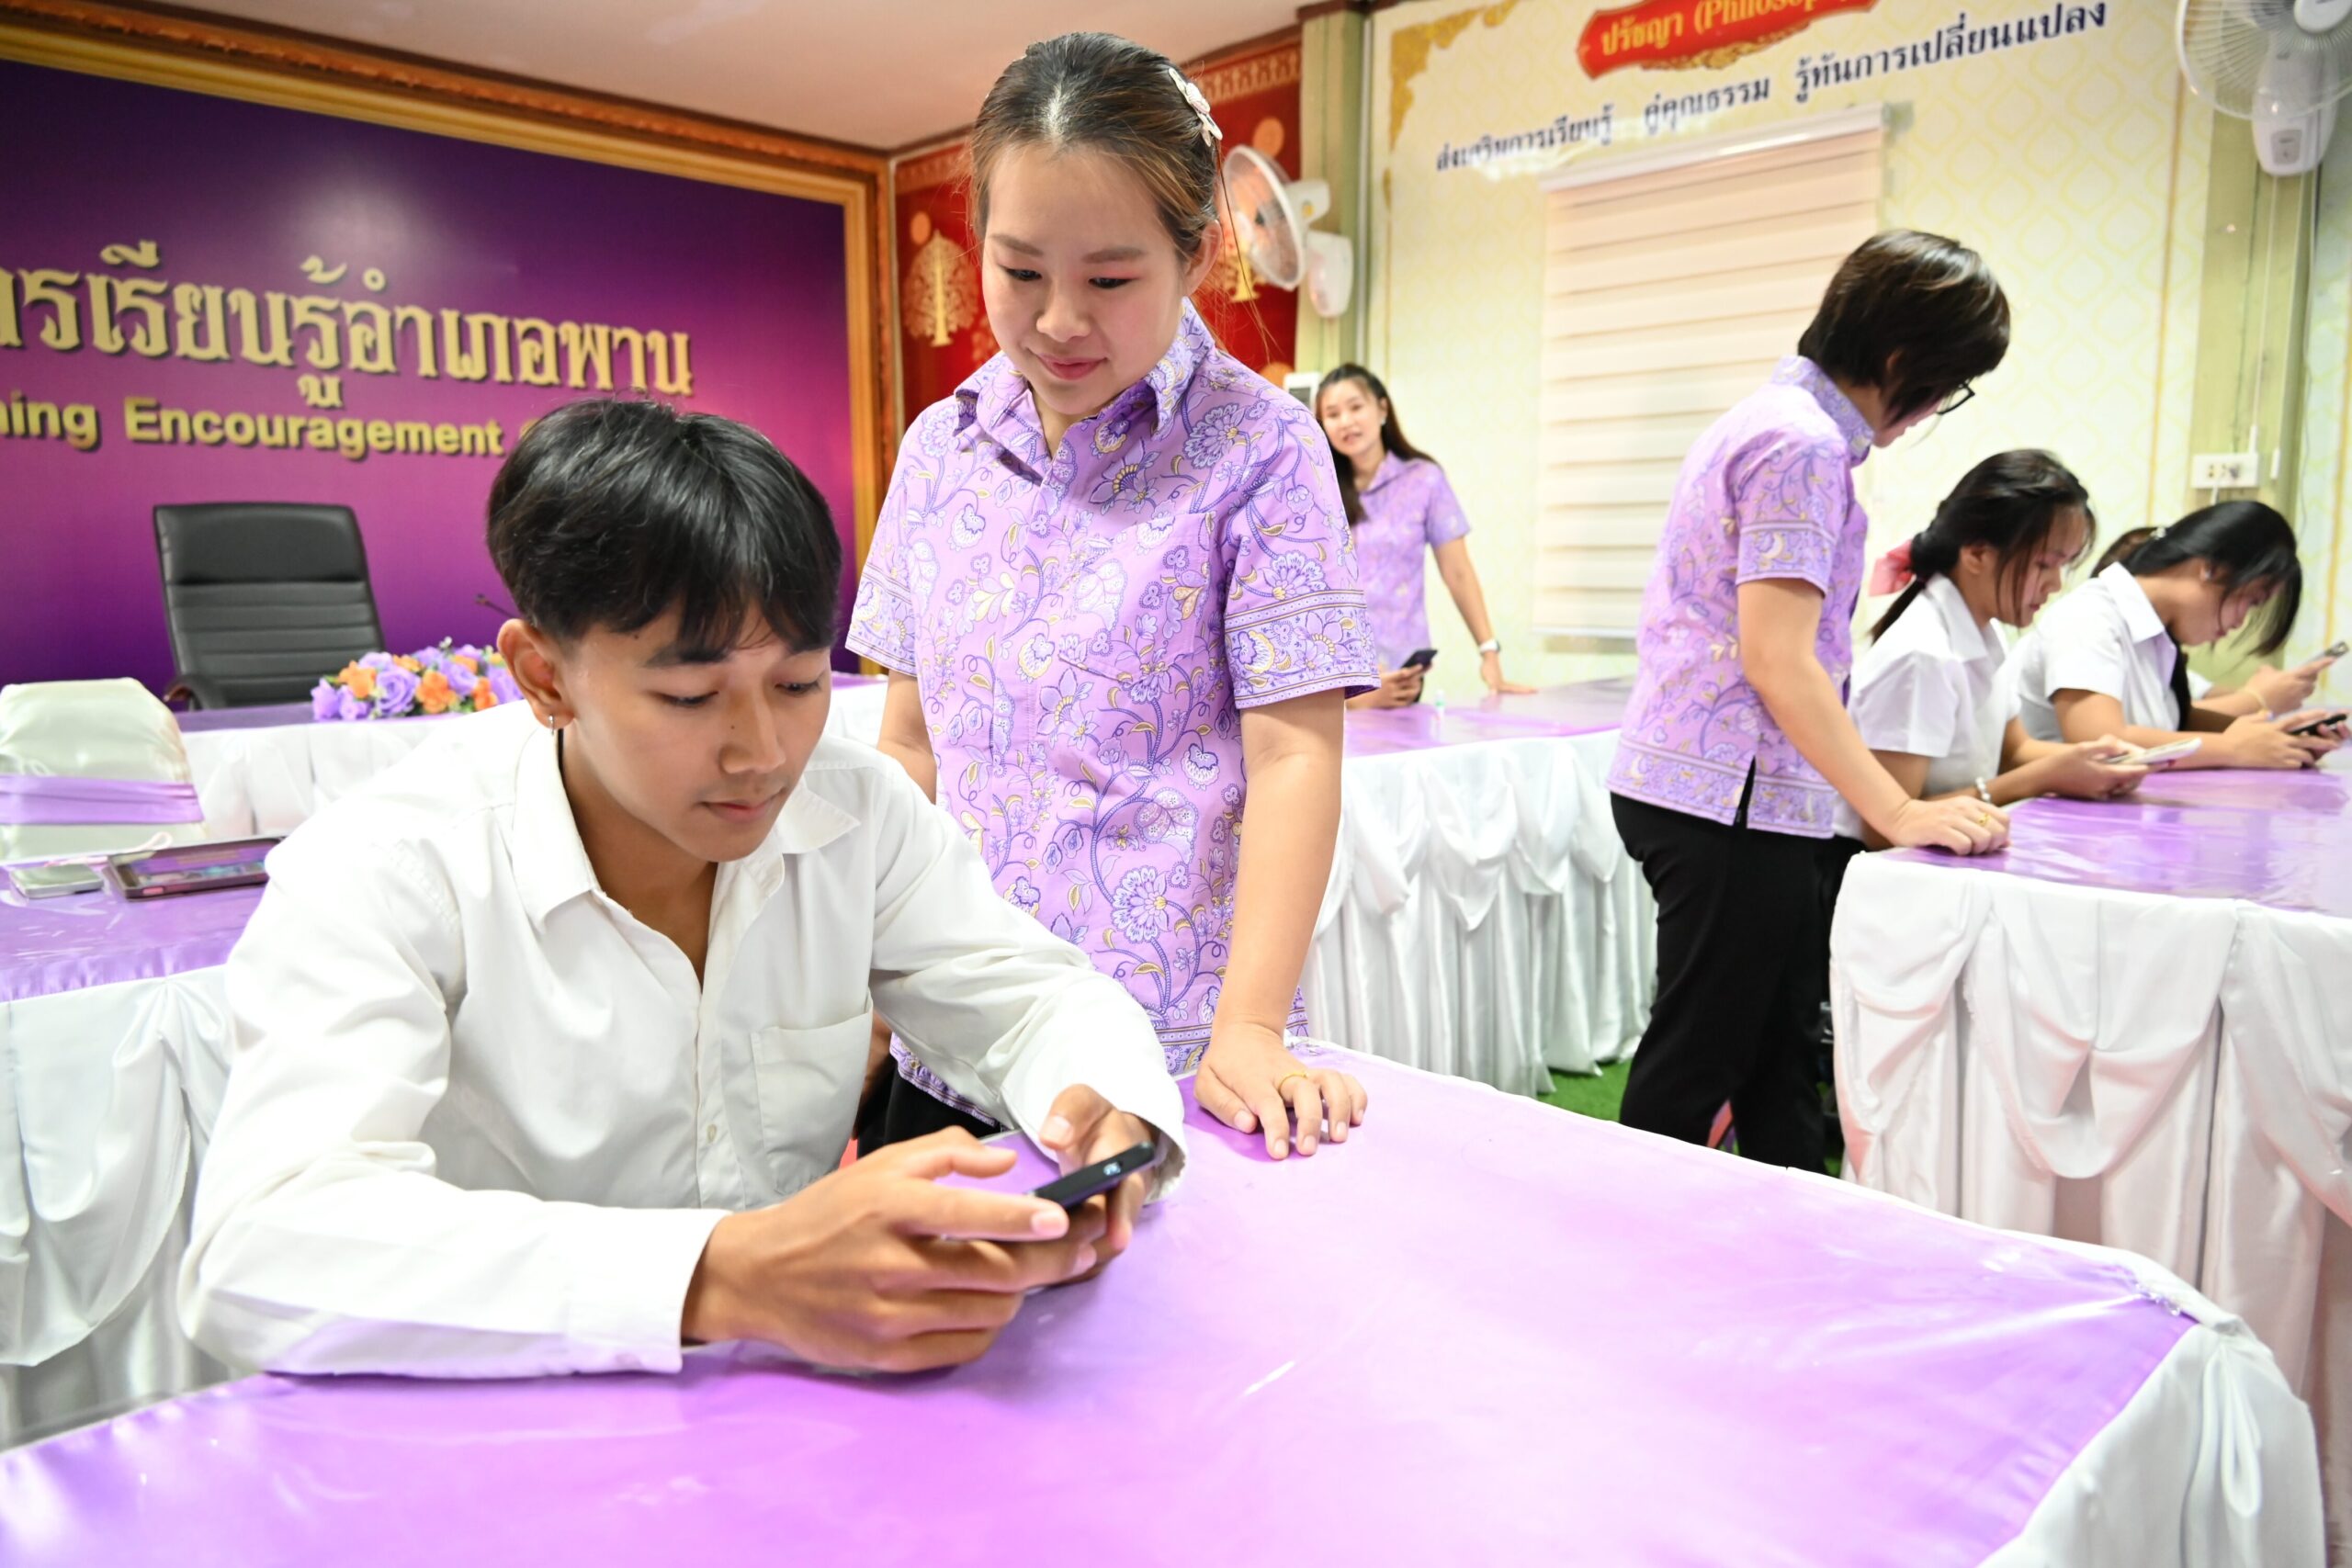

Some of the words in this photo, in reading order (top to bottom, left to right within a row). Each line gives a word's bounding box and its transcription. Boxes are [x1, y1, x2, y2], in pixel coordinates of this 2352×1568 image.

[1601, 12, 1683, 56] ปรัชญา
[1795, 2, 2107, 103] รู้ทันการเปลี่ยนแปลง
[0, 389, 98, 450] ing
[124, 396, 504, 460] Encouragement
